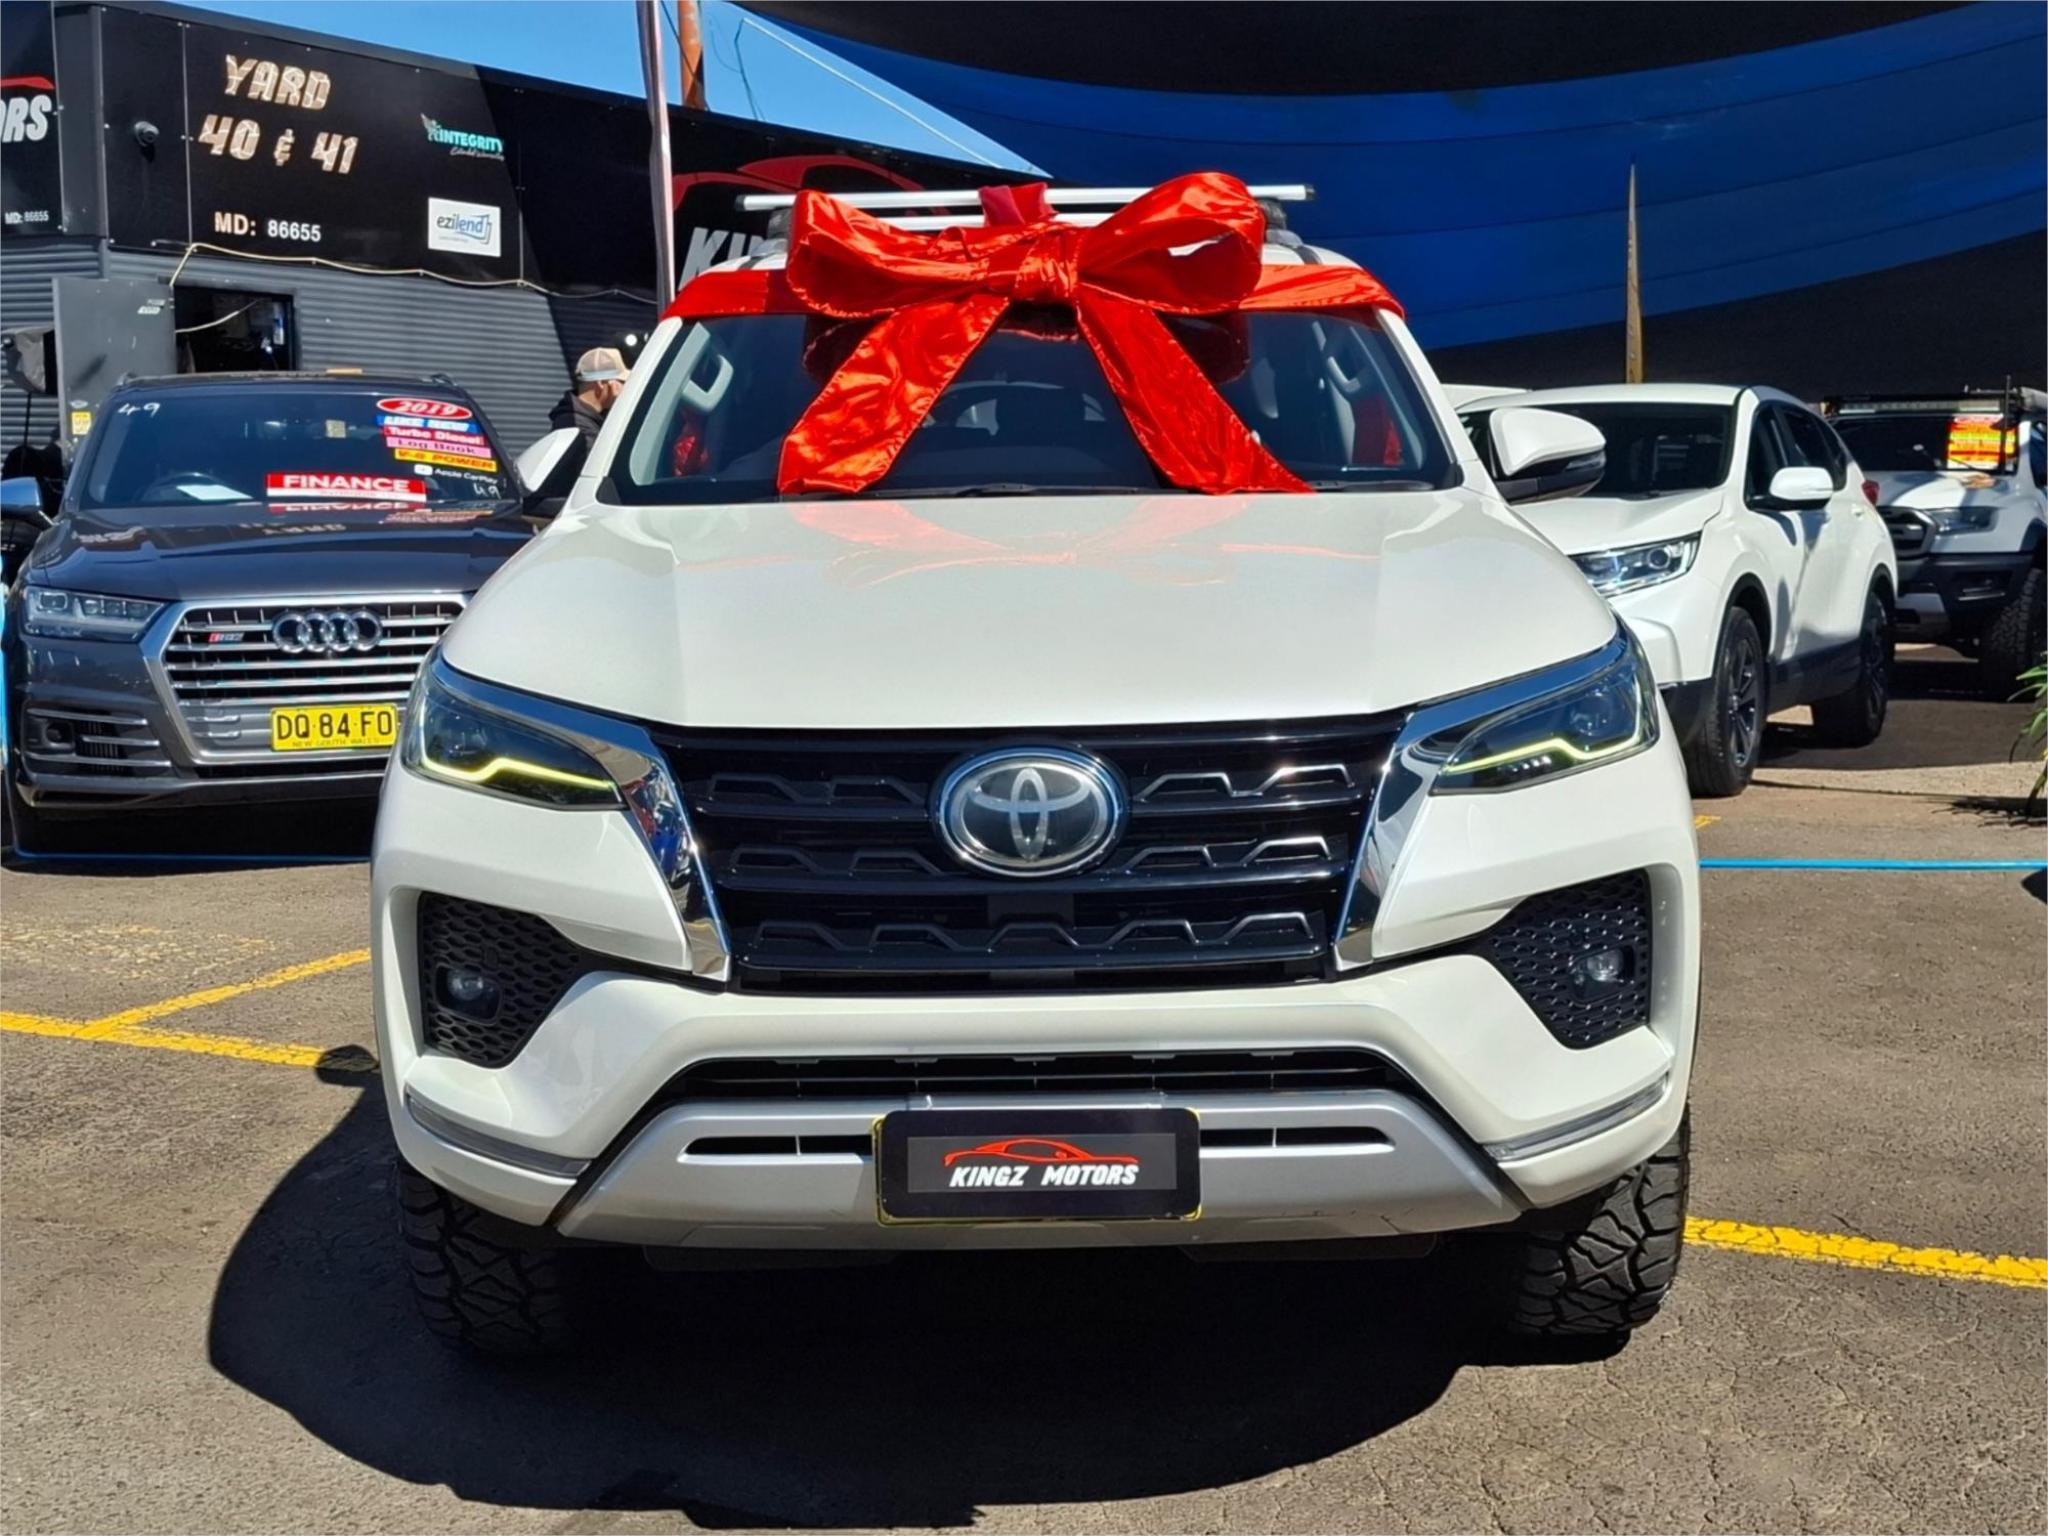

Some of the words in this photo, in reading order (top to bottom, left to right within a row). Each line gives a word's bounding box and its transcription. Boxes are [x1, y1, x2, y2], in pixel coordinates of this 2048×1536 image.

[225, 54, 331, 110] YARD
[0, 95, 52, 143] RS
[199, 114, 260, 161] 40
[311, 131, 359, 174] 41
[215, 211, 256, 236] MD:
[267, 219, 321, 242] 86655
[437, 213, 485, 234] ezilend
[678, 226, 764, 291] KI
[117, 402, 161, 418] 49
[396, 400, 460, 416] 2019
[388, 426, 432, 439] Turbo
[434, 430, 484, 446] Diesel
[397, 438, 428, 449] Log
[434, 442, 477, 455] Book
[431, 454, 495, 469] POWER
[283, 474, 411, 493] FINANCE
[434, 468, 463, 479] Apple
[463, 472, 499, 486] CarPlay
[319, 712, 351, 739] 84
[949, 1165, 1030, 1188] KINGZ
[1040, 1164, 1140, 1186] MOTORS
